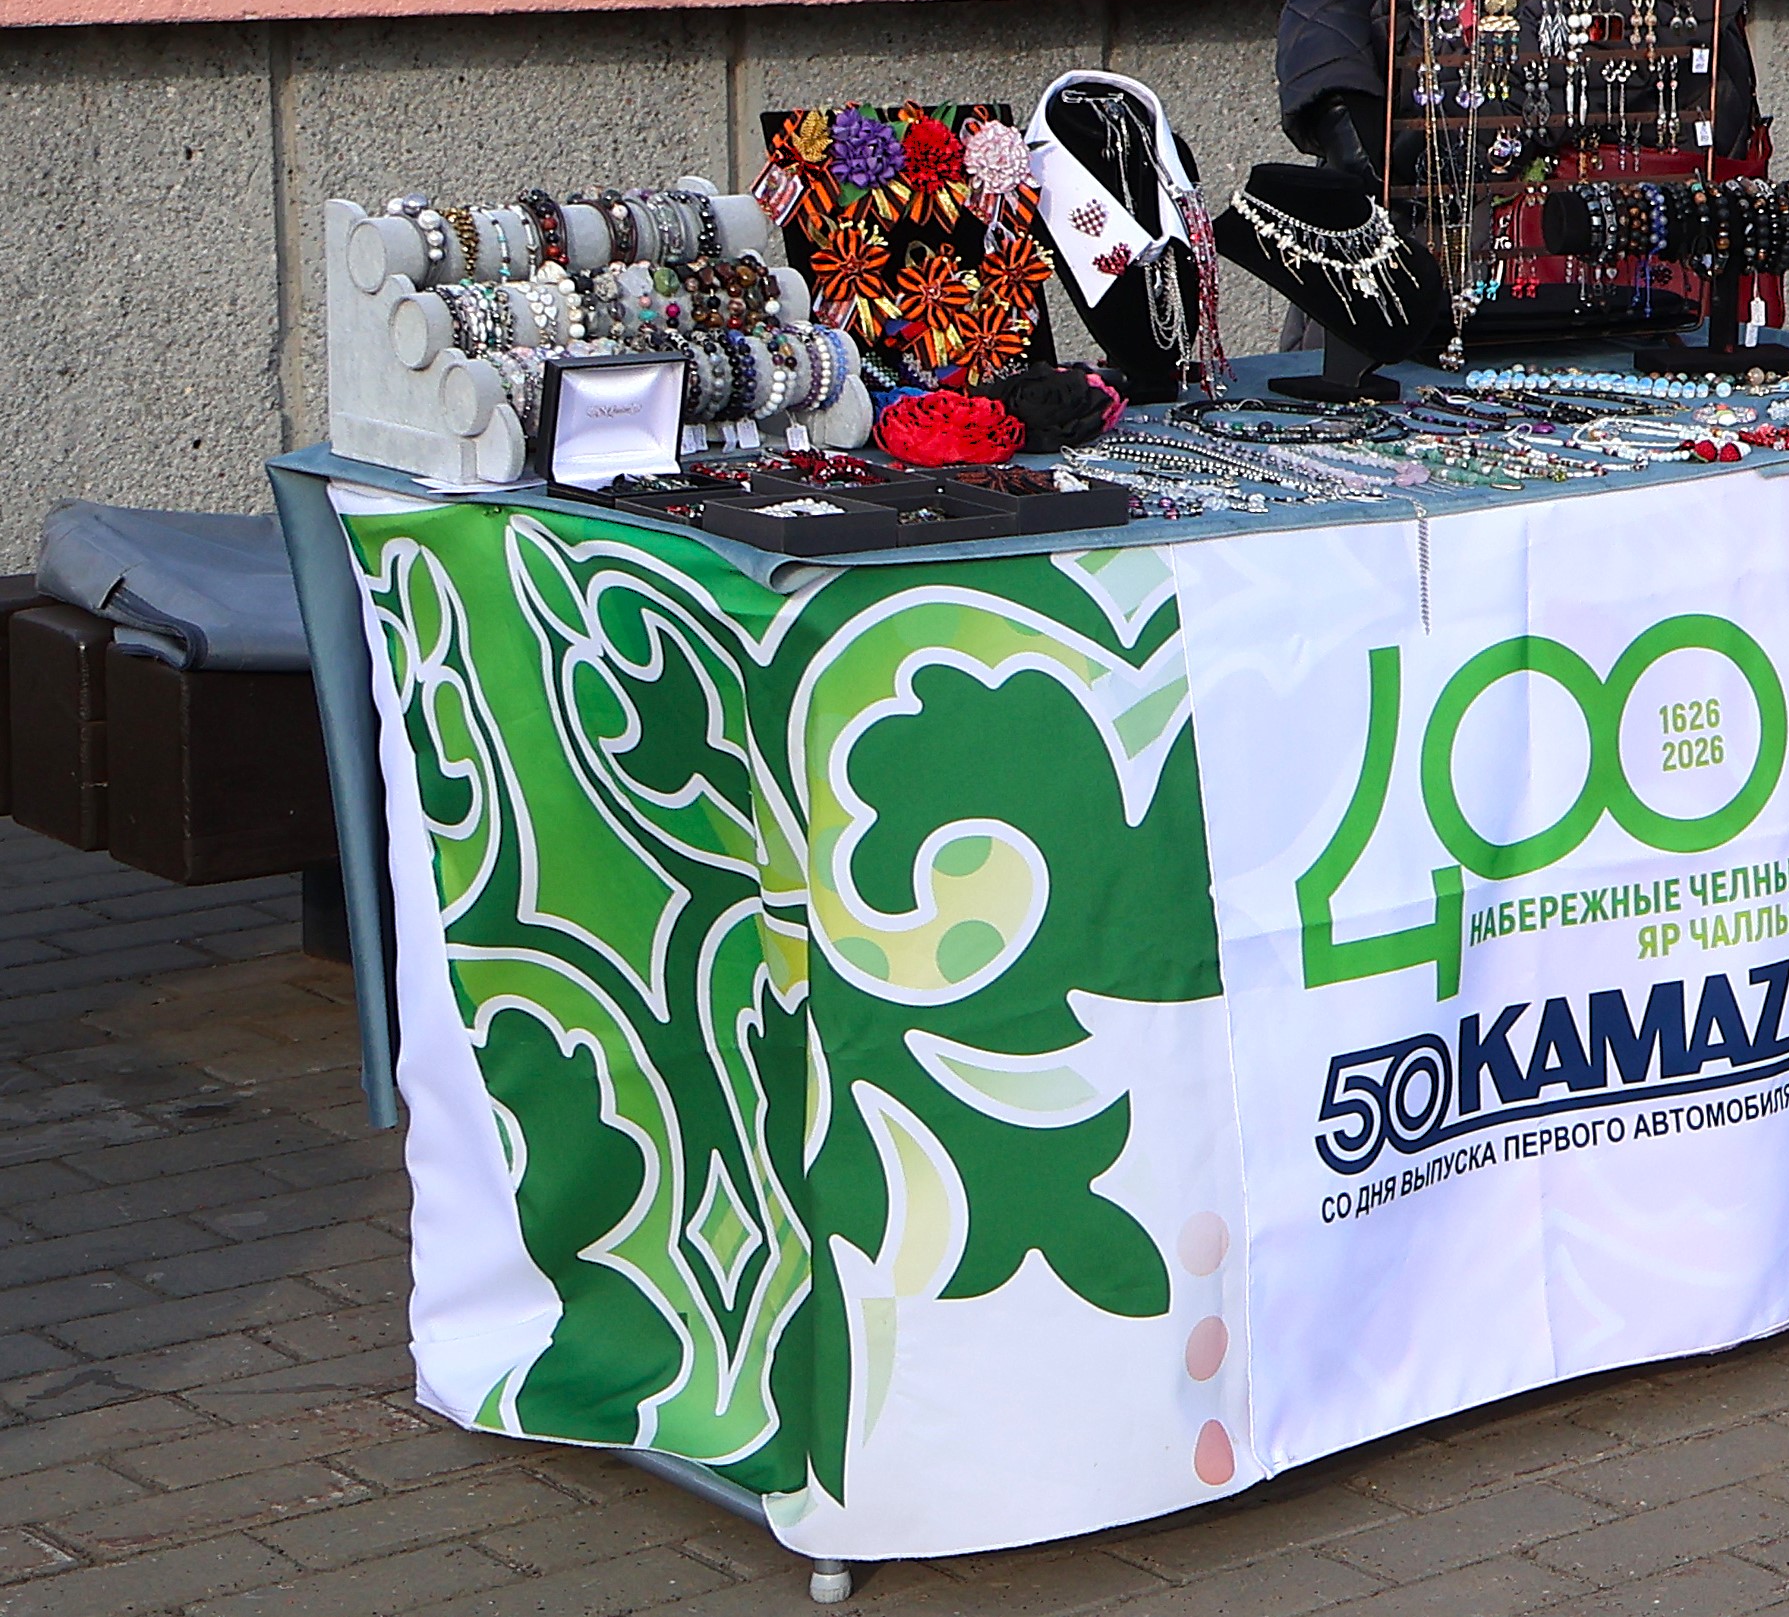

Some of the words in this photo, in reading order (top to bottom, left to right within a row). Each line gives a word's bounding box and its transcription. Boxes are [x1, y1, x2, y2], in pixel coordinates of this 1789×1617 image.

[1659, 698, 1721, 735] 1626
[1662, 734, 1724, 772] 2026
[1295, 613, 1789, 1002] 400
[1470, 877, 1681, 947] НАБЕРЕЖНЫЕ
[1638, 922, 1681, 959] ЯР
[1322, 1192, 1351, 1223] СО
[1355, 1175, 1397, 1219] ДНЯ
[1400, 1141, 1497, 1197] ВЫПУСКА
[1504, 1117, 1625, 1162] ПЕРВОГО
